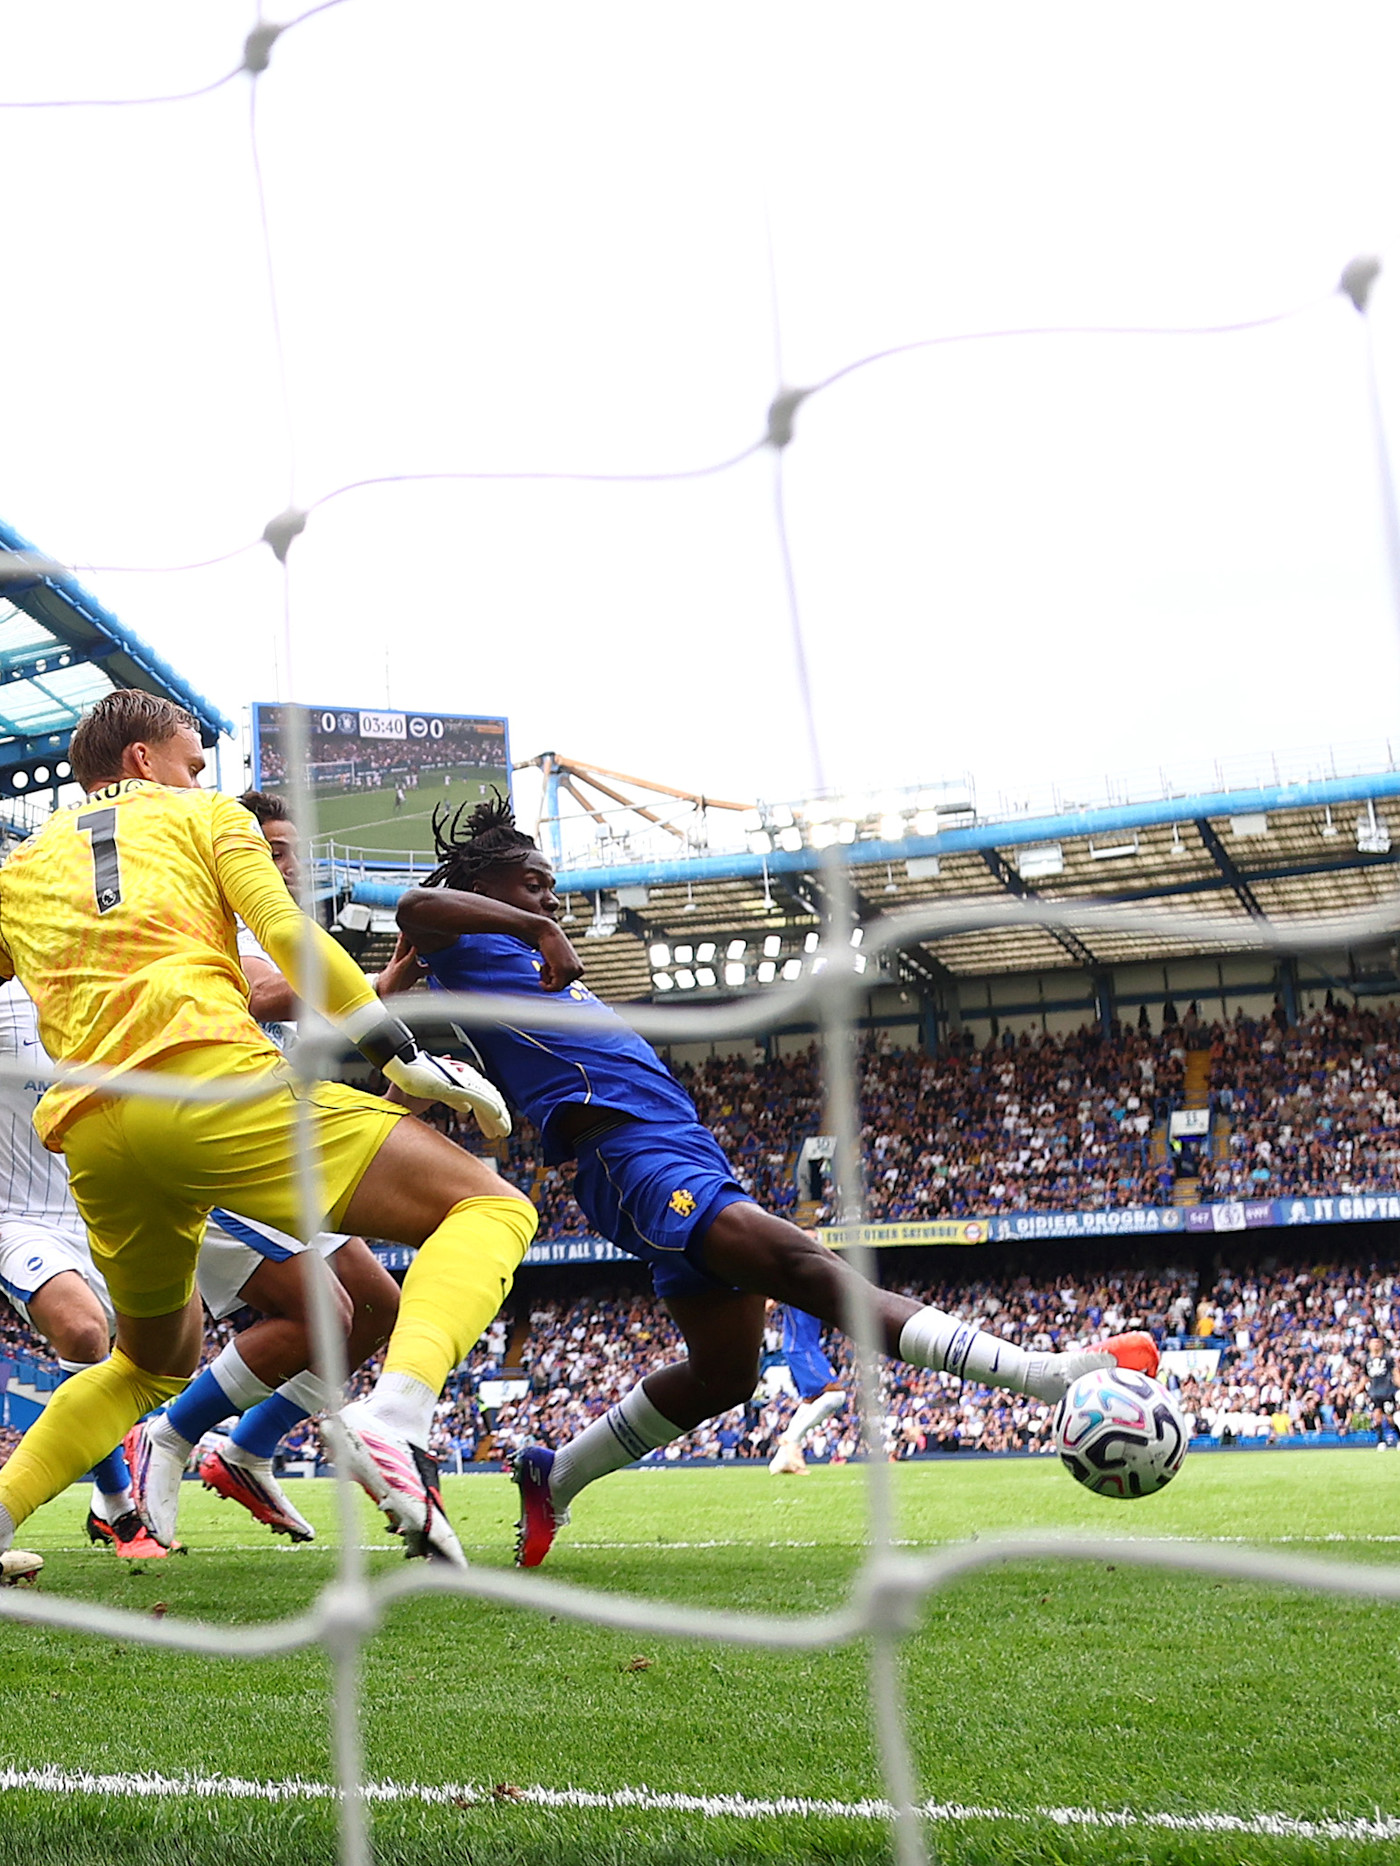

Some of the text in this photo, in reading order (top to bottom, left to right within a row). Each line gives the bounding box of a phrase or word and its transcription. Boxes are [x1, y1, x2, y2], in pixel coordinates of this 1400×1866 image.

[321, 712, 444, 739] 0 03:40 0
[77, 807, 123, 915] 1
[1314, 1199, 1334, 1220] JT
[1016, 1210, 1159, 1233] DIDIER DROGBA
[864, 1229, 898, 1240] OTHER
[903, 1226, 958, 1238] SATURDAY
[552, 1244, 566, 1260] IT
[568, 1242, 591, 1259] ALL
